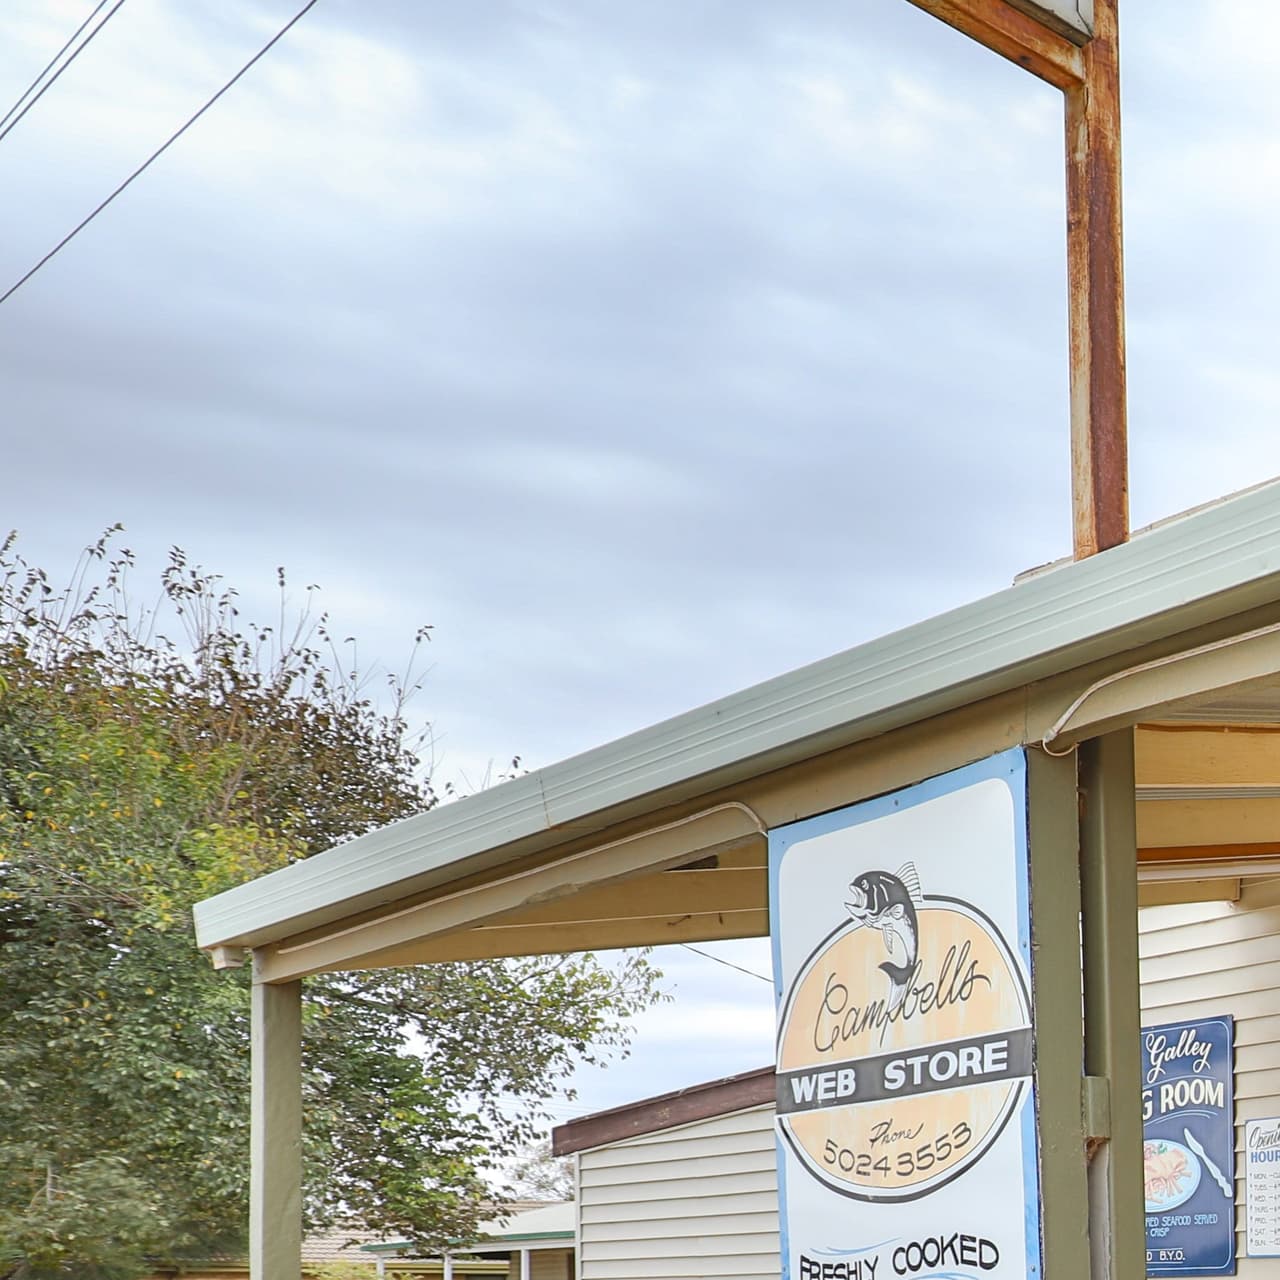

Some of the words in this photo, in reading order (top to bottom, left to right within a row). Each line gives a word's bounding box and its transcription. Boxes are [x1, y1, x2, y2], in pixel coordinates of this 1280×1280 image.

[814, 940, 991, 1052] Campbells
[791, 1067, 856, 1103] WEB
[884, 1040, 1009, 1090] STORE
[1146, 1029, 1213, 1083] Galley
[1160, 1078, 1224, 1114] ROOM
[869, 1118, 924, 1149] Phone
[1150, 1227, 1170, 1237] CRISP
[1162, 1215, 1192, 1226] SEAFOOD
[1194, 1213, 1218, 1224] SERVED
[893, 1233, 1000, 1275] COOKED
